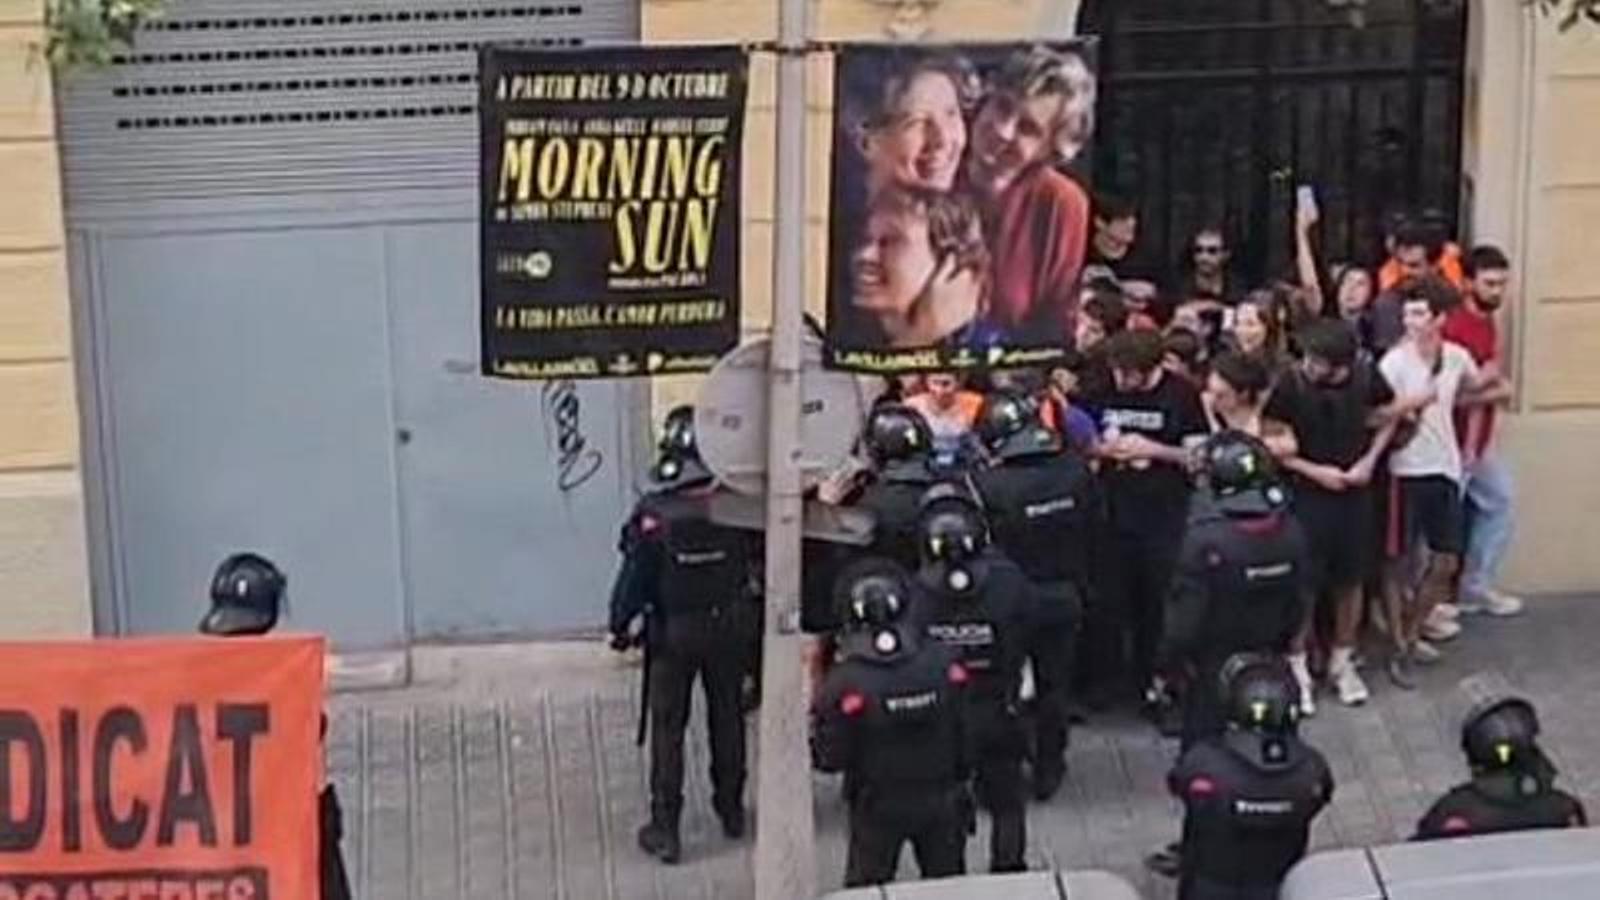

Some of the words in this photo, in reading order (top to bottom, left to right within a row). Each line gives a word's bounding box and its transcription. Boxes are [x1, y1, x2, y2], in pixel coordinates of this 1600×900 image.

[496, 74, 507, 101] A
[510, 73, 577, 100] PARTIR
[578, 73, 612, 100] DEL
[498, 134, 726, 201] MORNING
[608, 197, 718, 273] SUN
